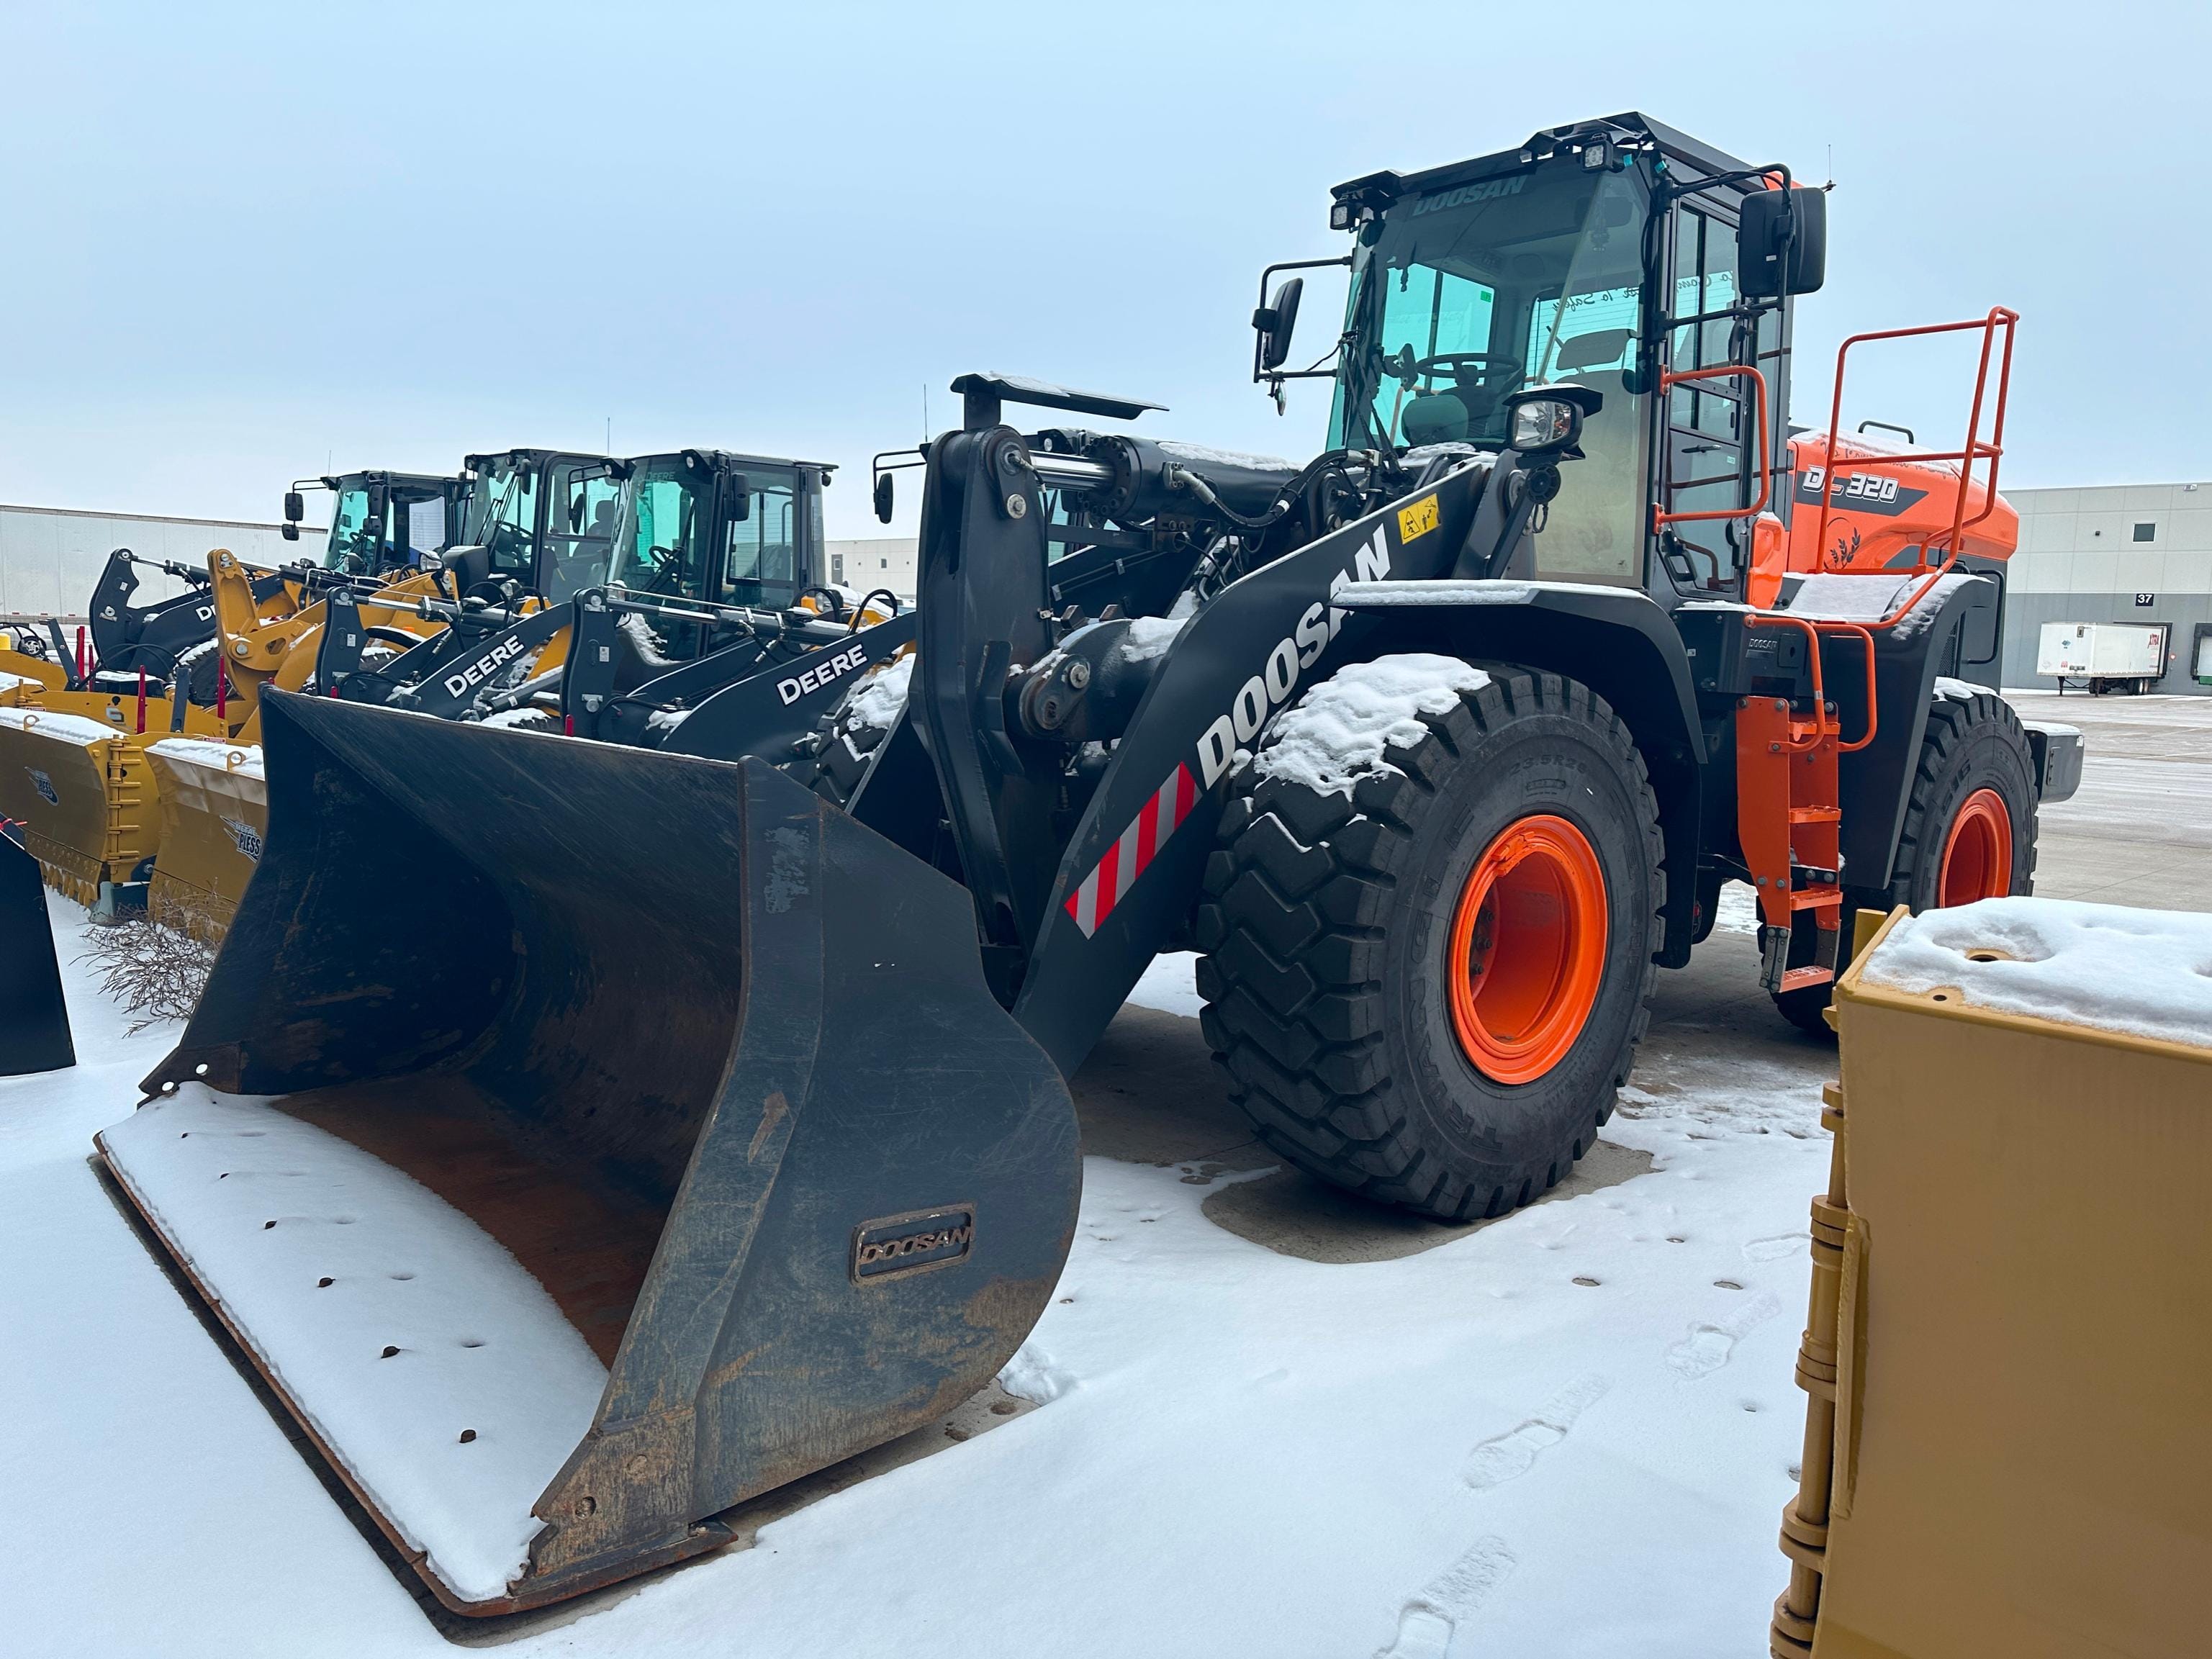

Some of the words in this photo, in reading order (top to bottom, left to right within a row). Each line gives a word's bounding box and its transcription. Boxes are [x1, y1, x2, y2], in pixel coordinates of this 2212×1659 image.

[646, 471, 676, 481] DEERE
[2137, 594, 2152, 604] 37
[444, 635, 525, 698] DEERE
[777, 643, 867, 705] DEERE
[1196, 523, 1391, 791] DOOSAN
[239, 833, 261, 856] PLESS
[859, 1226, 972, 1266] DOOSAN
